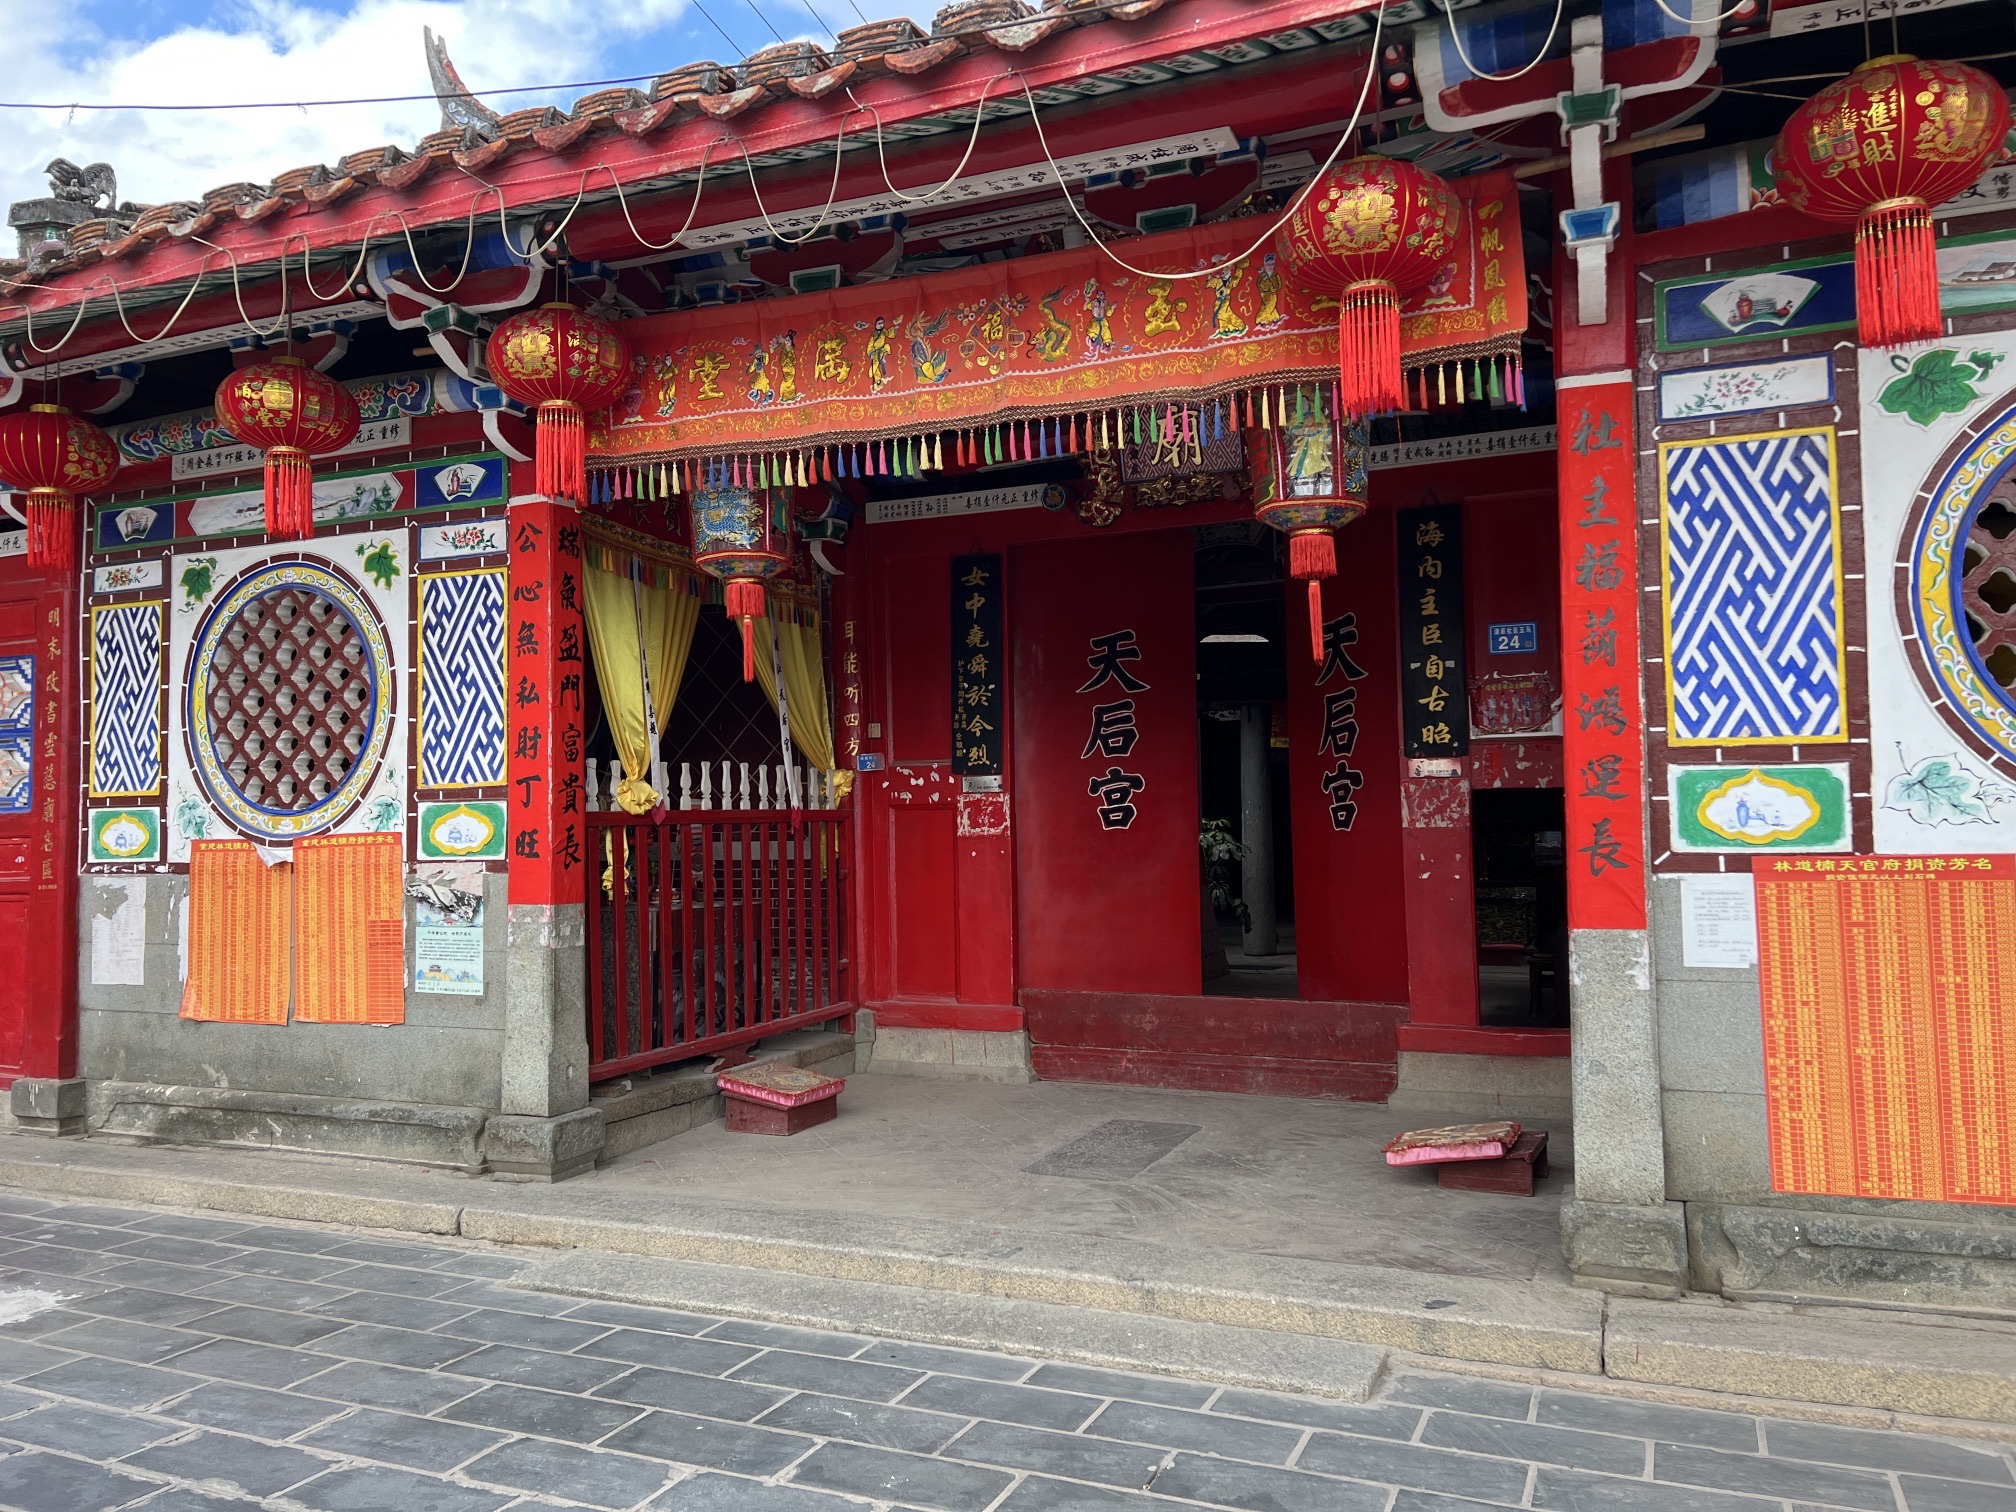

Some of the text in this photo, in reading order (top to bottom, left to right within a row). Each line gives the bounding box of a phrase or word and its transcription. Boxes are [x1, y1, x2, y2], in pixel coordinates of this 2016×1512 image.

[1861, 100, 1897, 167] 進財
[981, 312, 1005, 343] 福
[688, 350, 731, 400] 堂
[961, 566, 994, 767] 女中堯舜於今烈
[1498, 635, 1521, 650] 24
[514, 521, 544, 860] 公心無私財丁旺
[556, 524, 583, 871] 瑞氣盈門富貴長
[843, 620, 861, 756] 耳能听四方
[866, 761, 876, 769] 24
